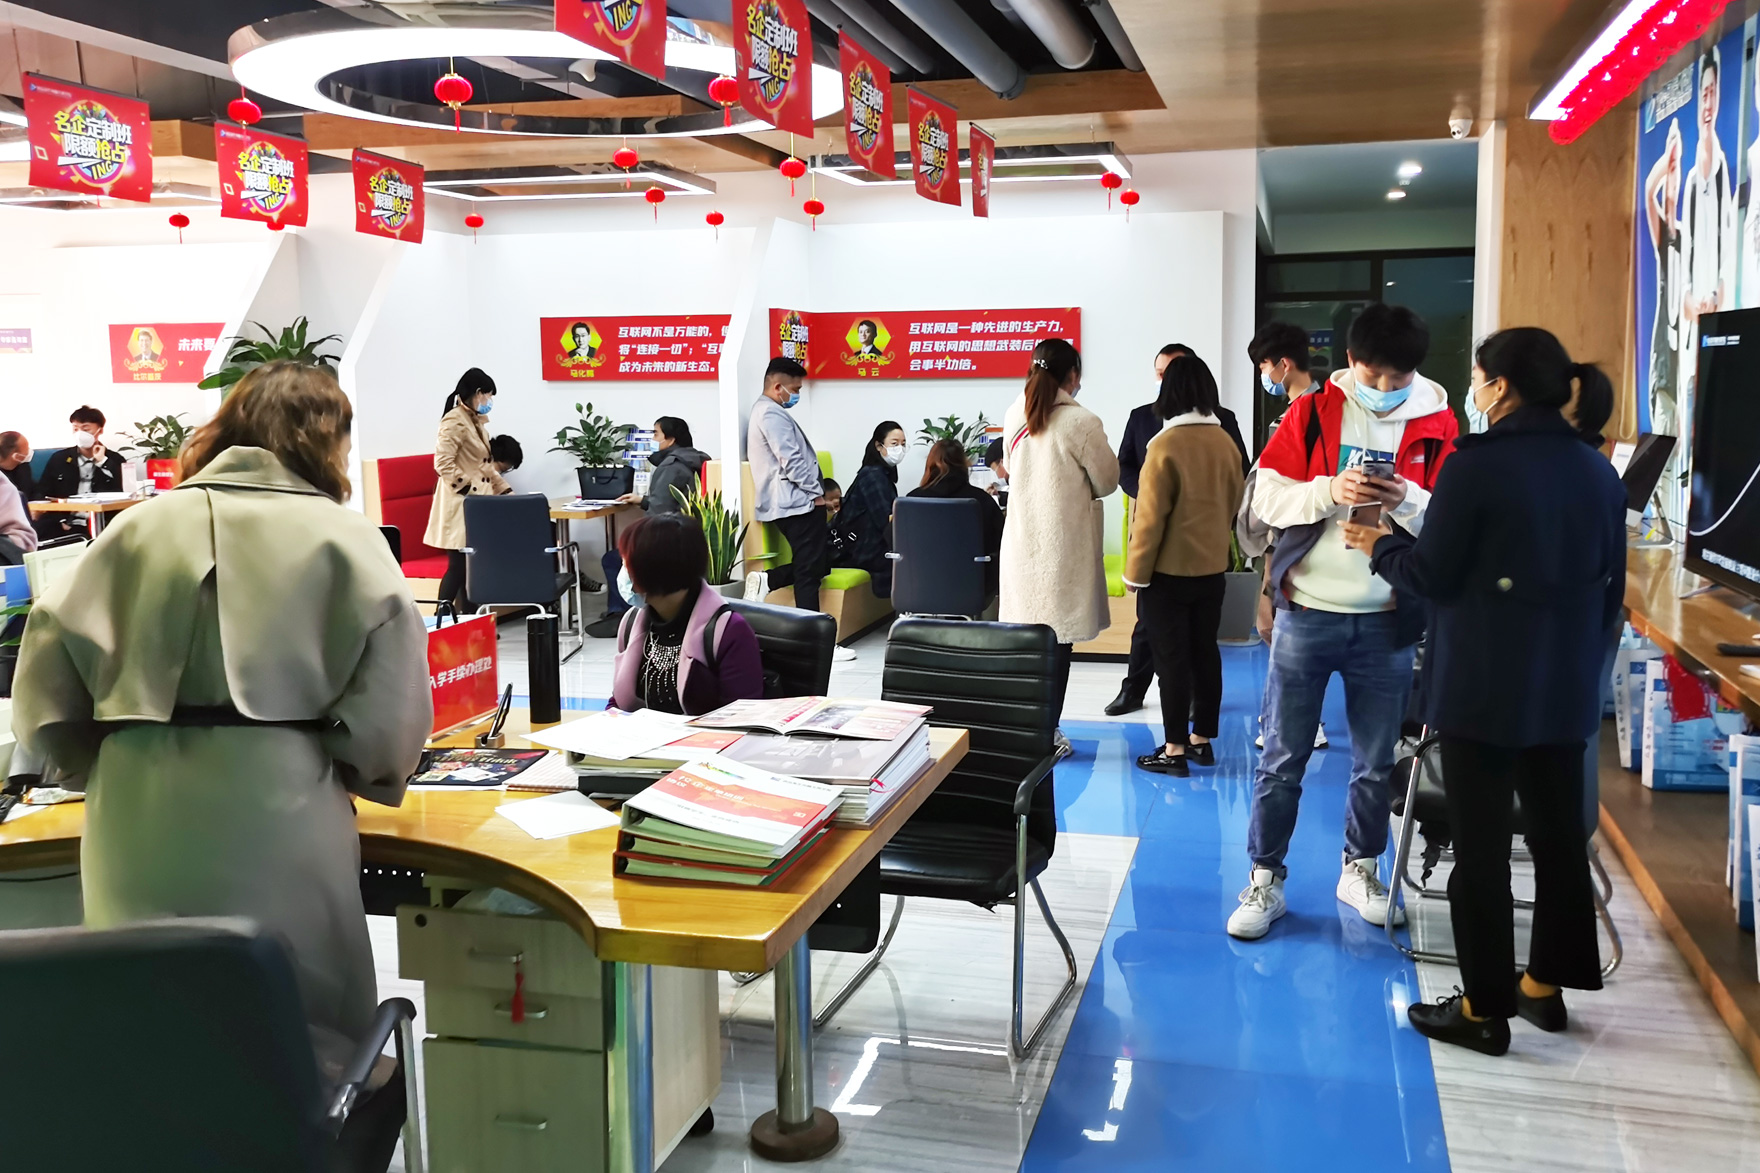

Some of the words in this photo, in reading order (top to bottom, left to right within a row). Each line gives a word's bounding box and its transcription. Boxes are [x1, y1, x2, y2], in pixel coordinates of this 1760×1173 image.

[613, 0, 633, 32] ING
[747, 3, 798, 57] 名企定制班
[751, 34, 792, 80] 限额抢占
[765, 77, 780, 102] ING
[54, 110, 133, 144] 名企定制班
[63, 132, 126, 163] 限额抢占
[91, 160, 113, 180] ING
[238, 151, 295, 178] 名企定制班
[264, 191, 280, 210] ING
[369, 175, 414, 201] 名企定制班
[908, 320, 1064, 335] 互联网是一种先进的生产力，
[178, 337, 217, 352] 未来要
[618, 360, 716, 373] 成为未来的新生态。
[857, 367, 880, 377] 马云
[909, 358, 977, 371] 会事半功倍。
